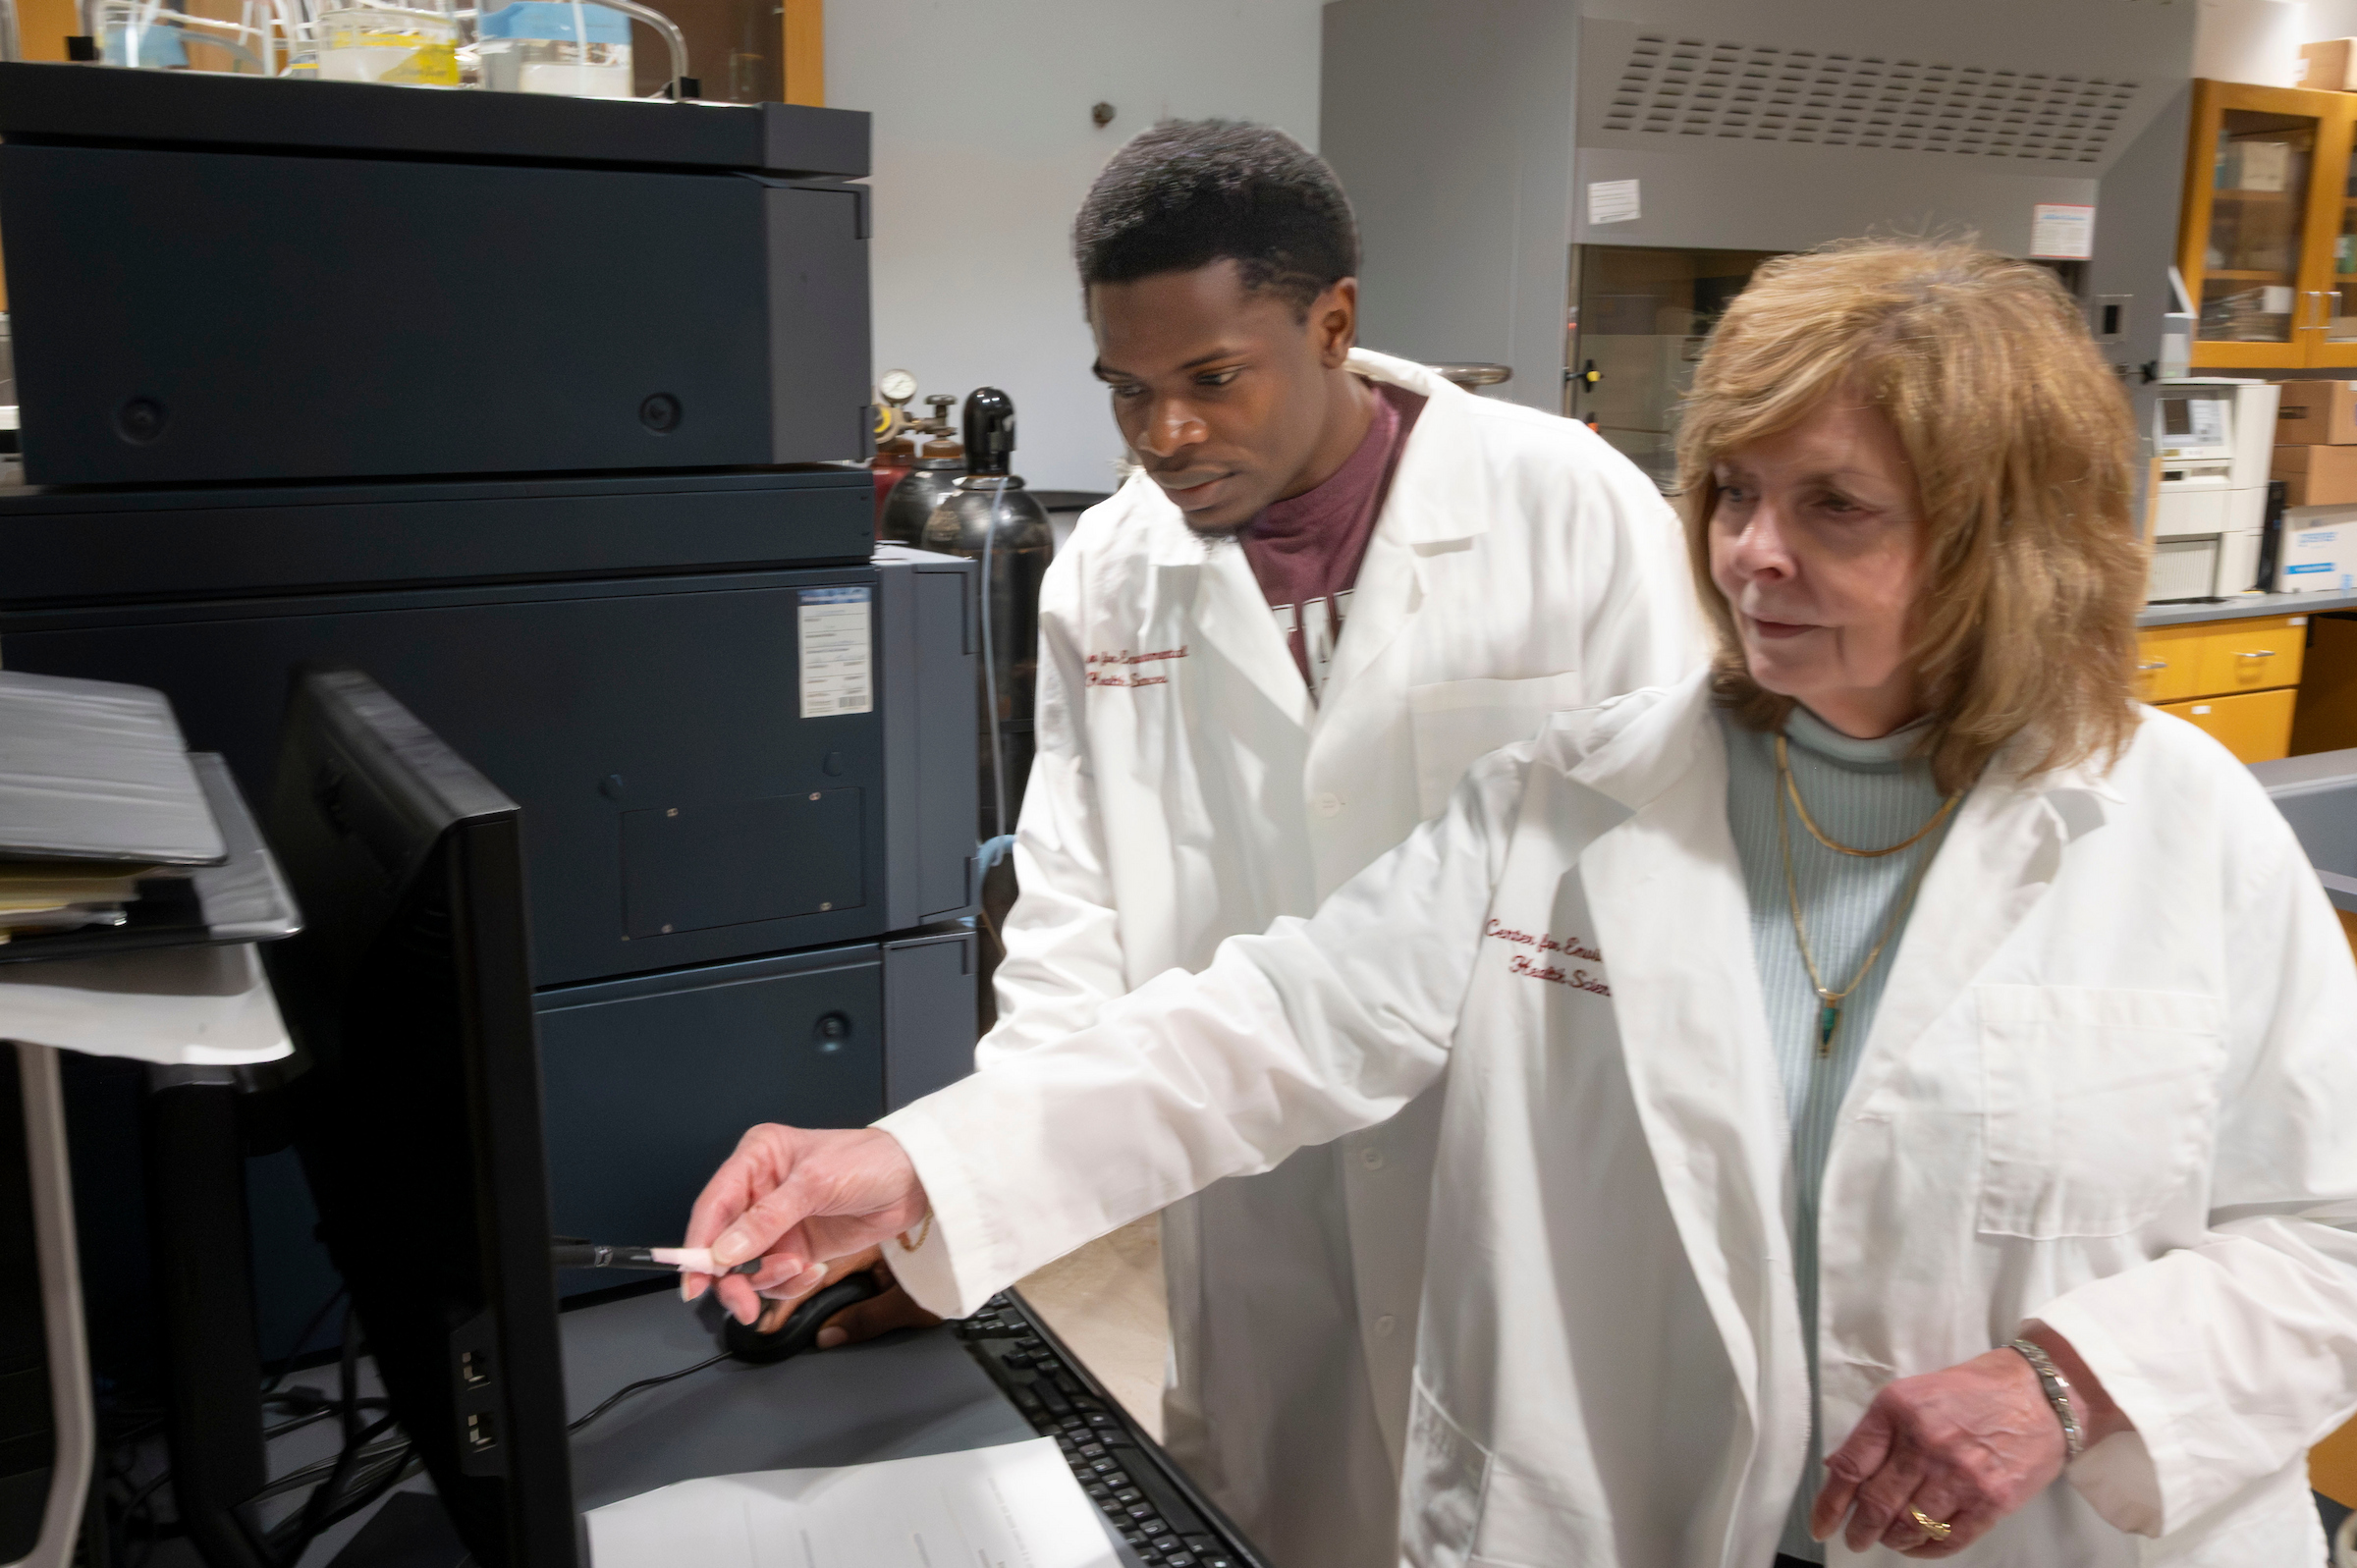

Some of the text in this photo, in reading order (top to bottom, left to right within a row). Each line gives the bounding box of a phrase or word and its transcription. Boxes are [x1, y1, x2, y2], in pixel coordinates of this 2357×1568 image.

[1485, 918, 1536, 946] Center
[1536, 933, 1562, 952] for
[1508, 954, 1568, 984] Health
